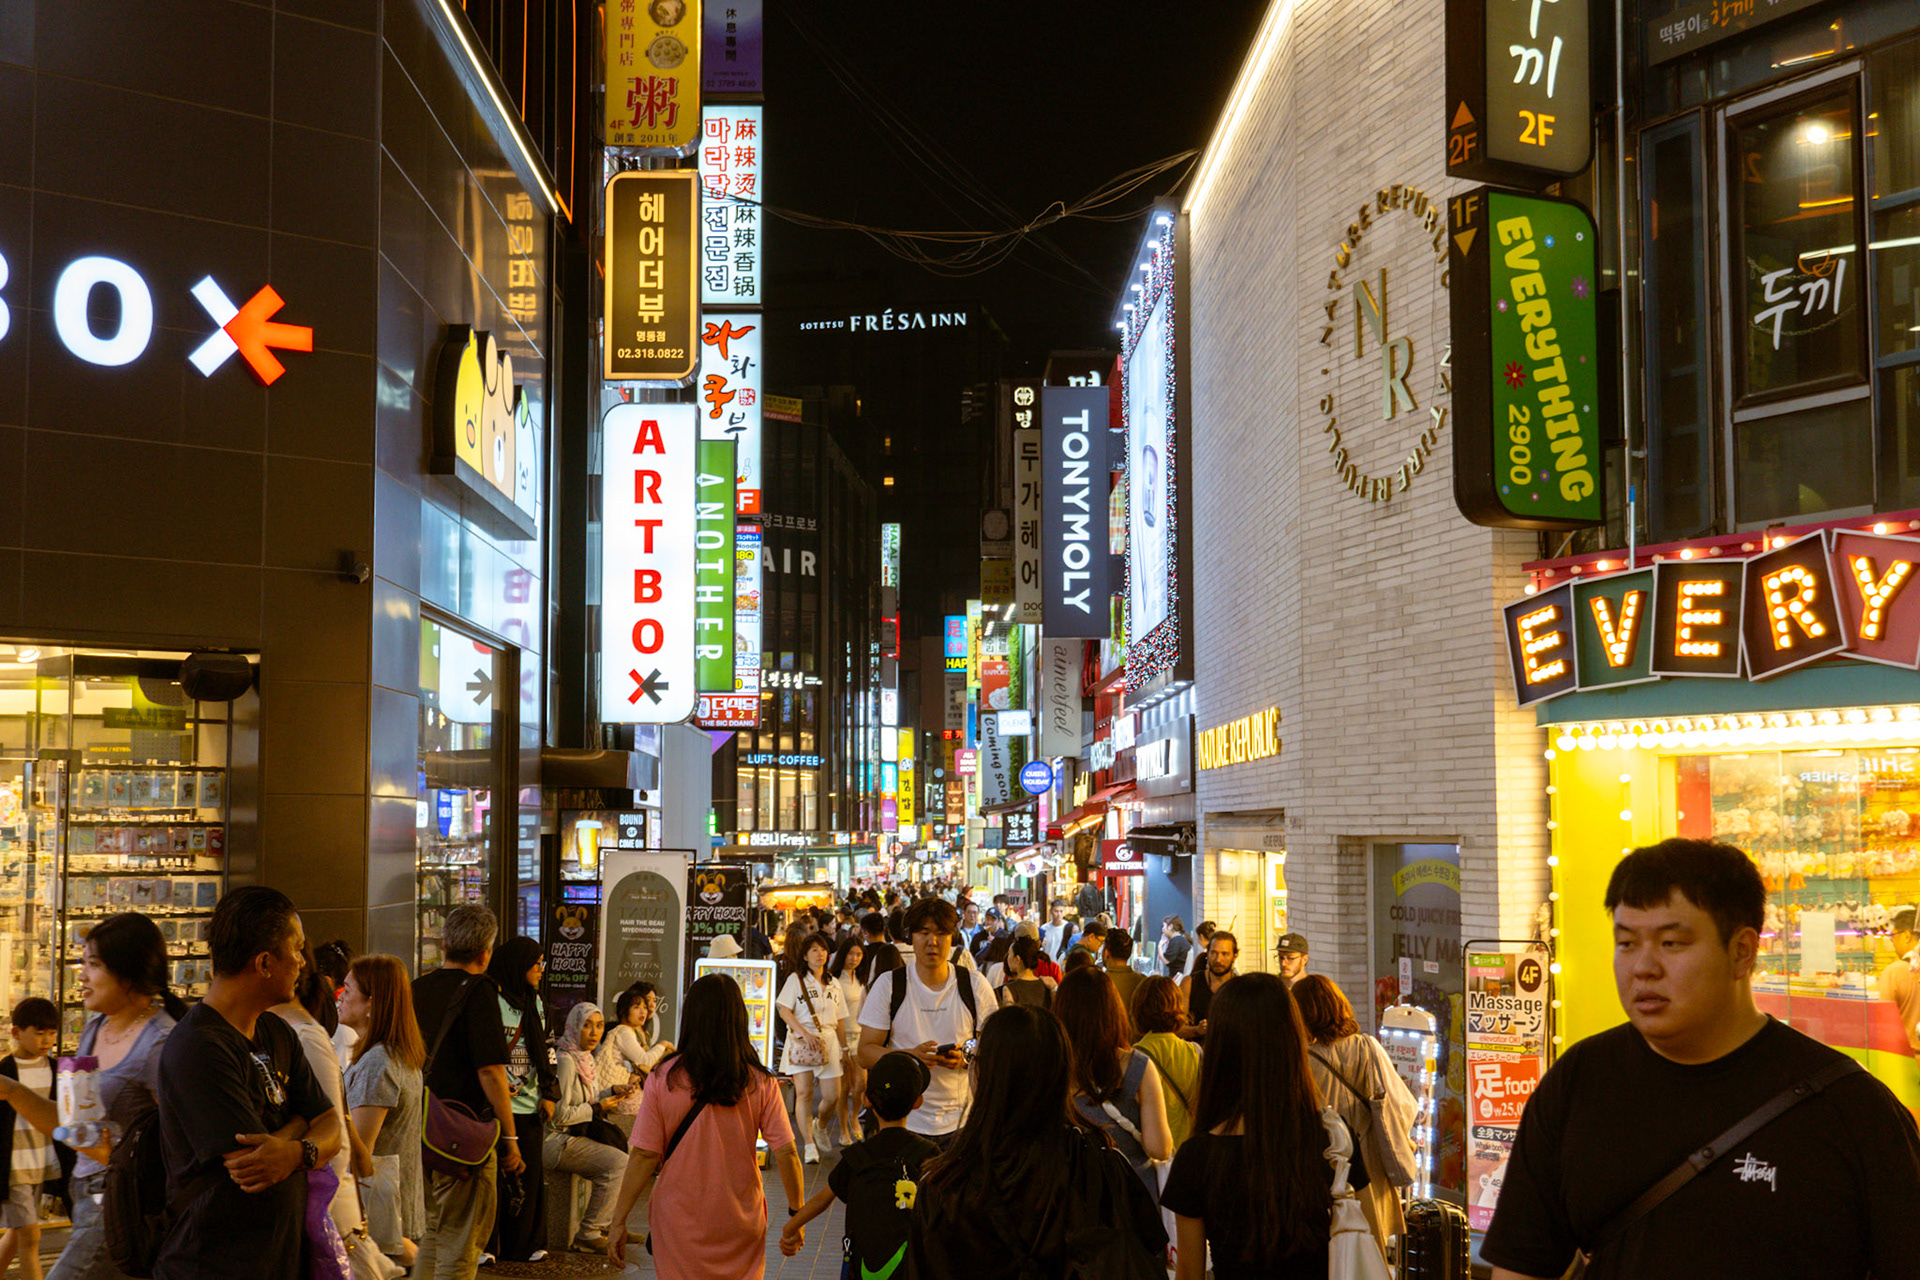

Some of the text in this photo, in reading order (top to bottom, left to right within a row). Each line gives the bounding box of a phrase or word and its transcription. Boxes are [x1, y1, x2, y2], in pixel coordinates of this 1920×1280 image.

[626, 75, 679, 129] 粥
[609, 119, 625, 130] 4F
[1518, 110, 1556, 147] 2F
[1449, 133, 1477, 167] 2F
[704, 117, 731, 292] 마라탕 전문점
[1452, 197, 1478, 229] 1F
[637, 192, 665, 324] 헤어더뷰
[1754, 259, 1846, 350] 두끼
[800, 309, 967, 332] SOTETSU FRÉSA INN
[617, 347, 684, 359] 02.318.0822
[1496, 216, 1595, 502] EVERYTHING 2900
[1020, 442, 1040, 589] 두가헤어
[1062, 408, 1091, 614] TONYMOLY
[889, 525, 898, 561] HALAL
[627, 420, 669, 705] ARTBOX
[695, 472, 724, 660] ANOTHER
[1516, 553, 1919, 686] EVERY
[712, 697, 759, 710] 더식당
[984, 717, 1001, 769] Coming
[1198, 724, 1229, 770] NATURE
[1229, 707, 1281, 765] REPUBLIC
[747, 753, 819, 765] LUFT COFFEE
[1023, 778, 1049, 786] HOLIDAY
[619, 814, 644, 825] BOUND
[1007, 814, 1034, 828] 명동
[619, 839, 644, 848] COME ON
[1007, 828, 1034, 841] 교자
[714, 906, 745, 921] HOUR
[1390, 905, 1415, 921] COLD
[1417, 907, 1444, 927] JUICY
[715, 922, 740, 934] OFF
[551, 942, 592, 957] HAPPY
[1390, 934, 1430, 963] JELLY
[552, 957, 586, 972] HOUR
[1521, 965, 1539, 984] 4F
[549, 973, 589, 982] 20% OFF
[1470, 993, 1542, 1015] Massage
[1470, 1013, 1541, 1033] マッサージ
[1474, 1064, 1504, 1099] 足
[1504, 1077, 1537, 1095] foot
[1475, 1141, 1503, 1153] Whole body
